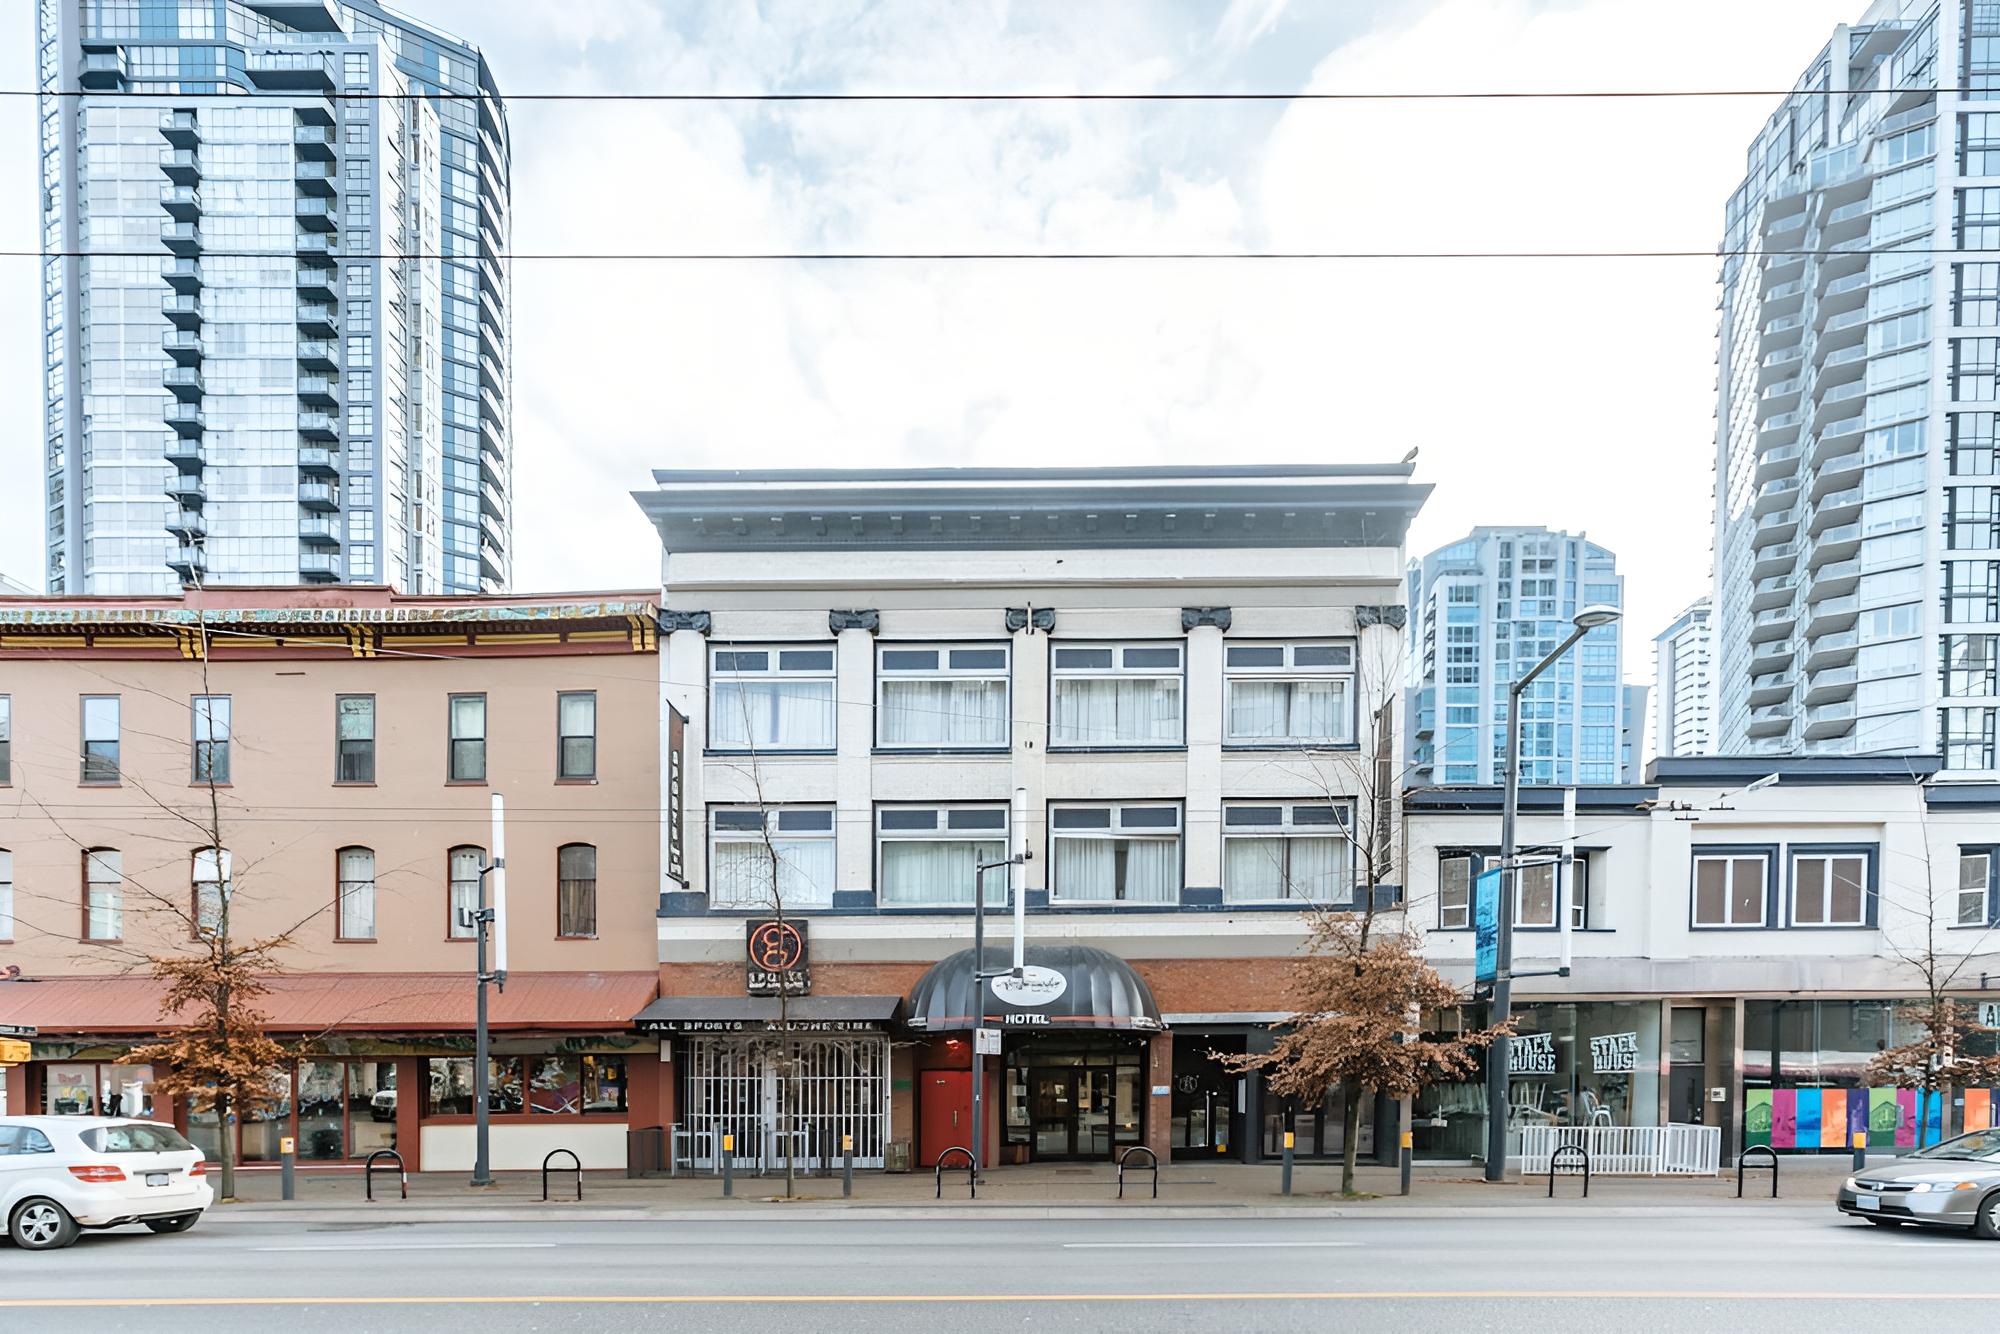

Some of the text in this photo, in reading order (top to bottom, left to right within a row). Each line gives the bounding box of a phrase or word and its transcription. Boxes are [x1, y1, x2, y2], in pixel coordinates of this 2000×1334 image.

[649, 1021, 677, 1030] ALL
[1005, 1013, 1050, 1024] HOTEL
[1590, 1034, 1639, 1056] STACK
[1509, 1053, 1556, 1071] HOUSE
